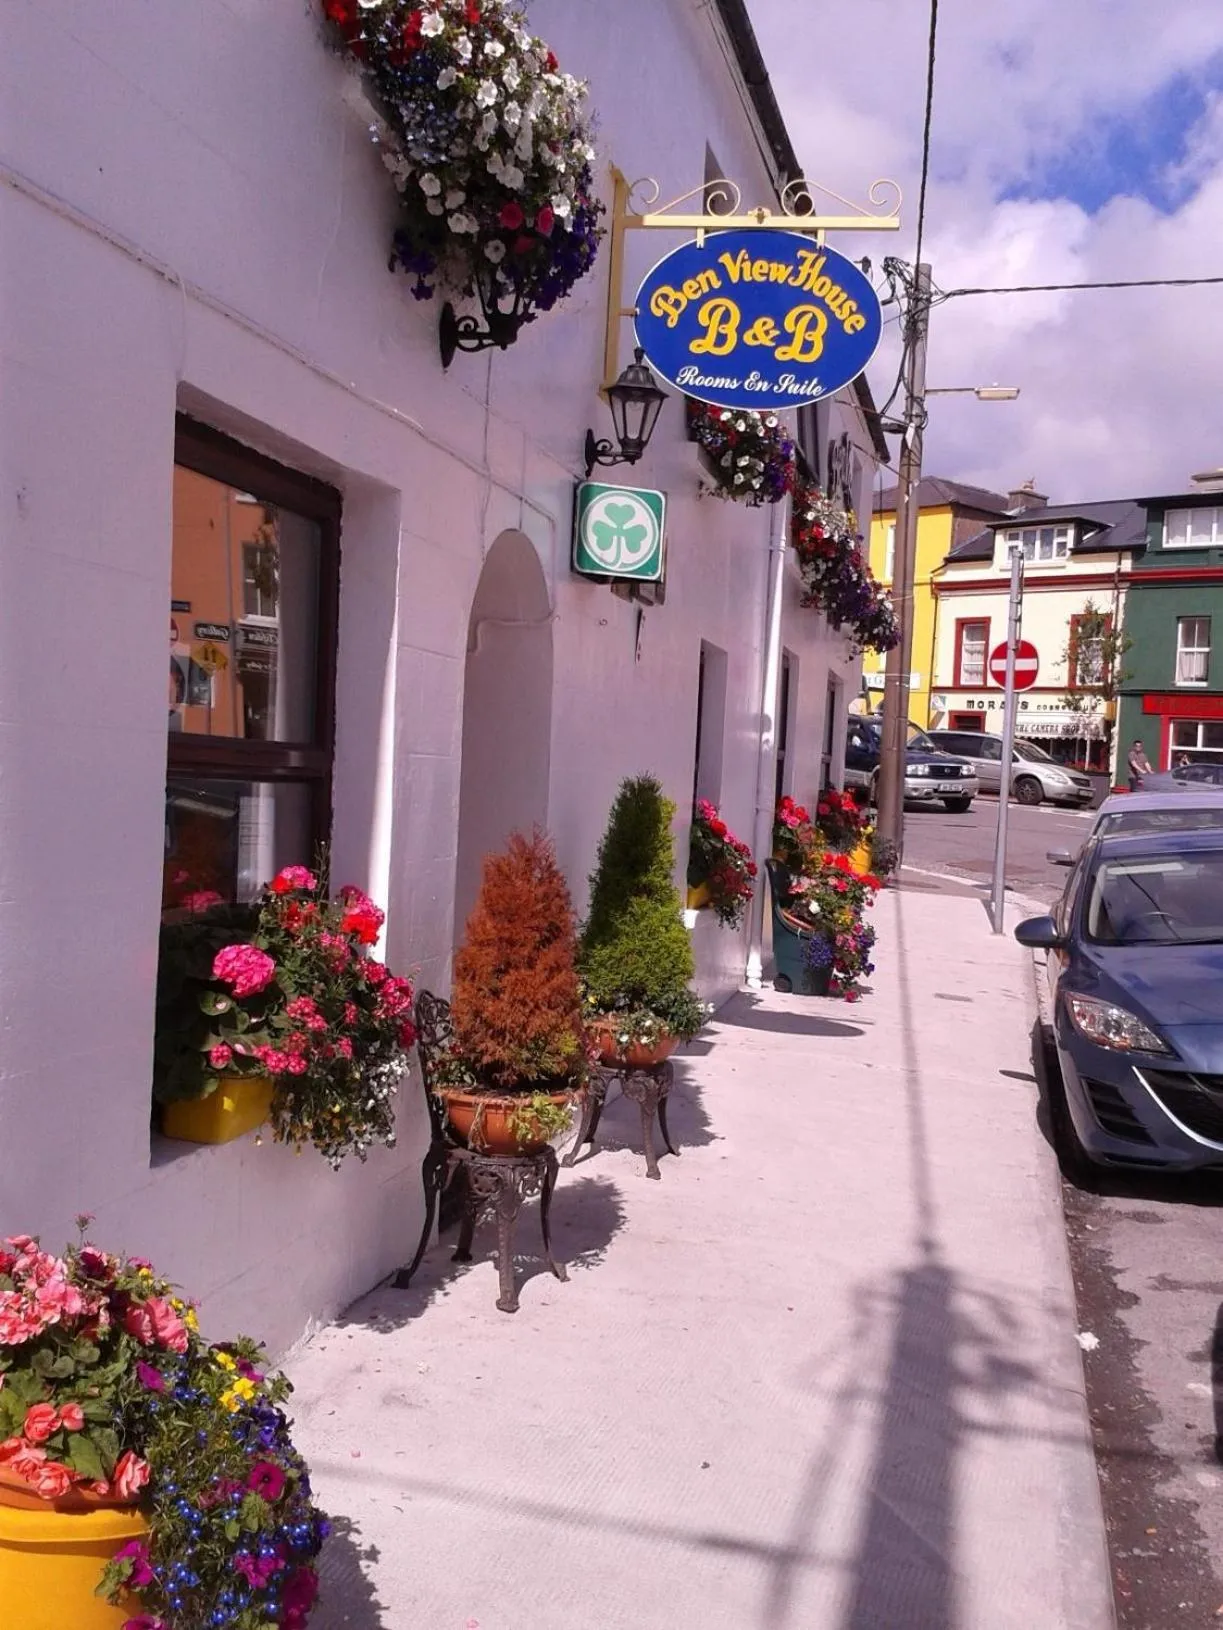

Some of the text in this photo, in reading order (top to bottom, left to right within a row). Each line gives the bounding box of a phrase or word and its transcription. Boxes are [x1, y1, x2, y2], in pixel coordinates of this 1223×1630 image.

[650, 249, 867, 335] Ben View House
[689, 297, 828, 363] B & B
[675, 365, 827, 397] Rooms En Suite
